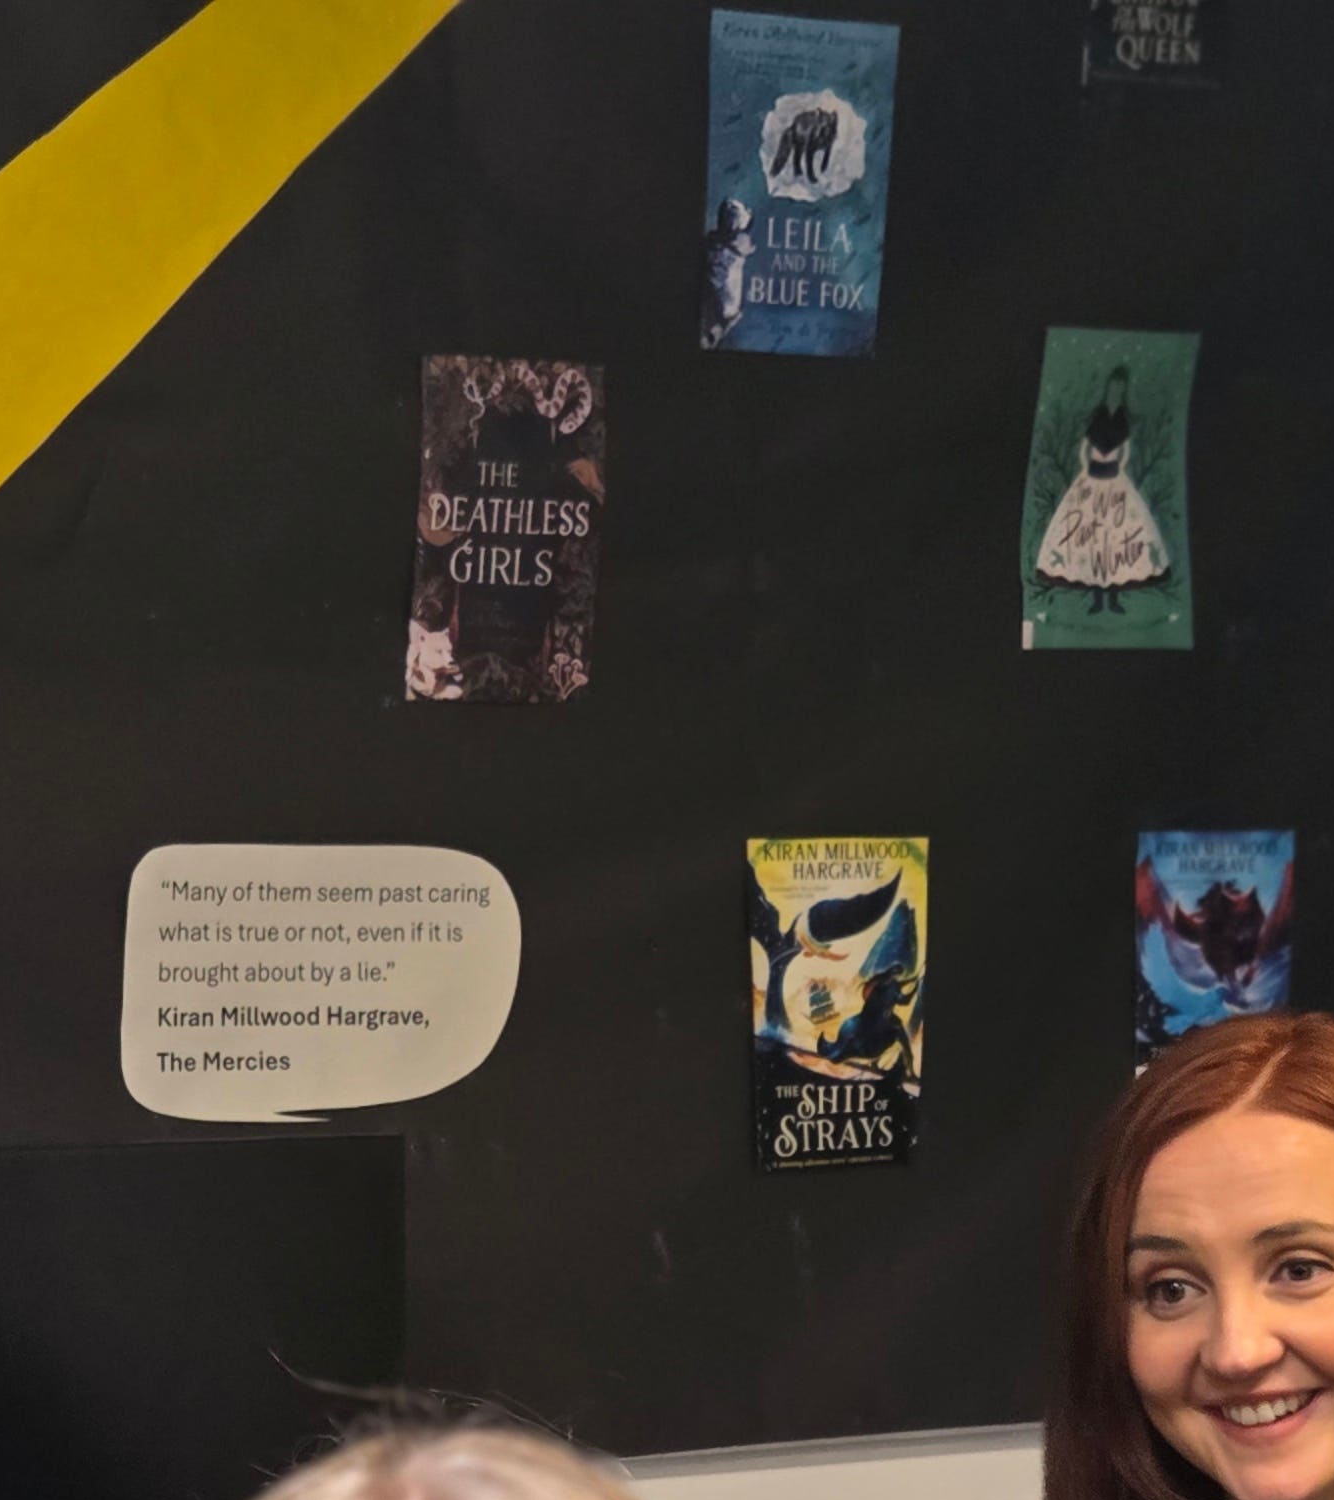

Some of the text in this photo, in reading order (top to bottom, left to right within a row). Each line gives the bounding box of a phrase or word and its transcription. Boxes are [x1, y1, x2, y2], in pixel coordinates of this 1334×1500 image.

[1137, 7, 1195, 36] WOLF
[1116, 34, 1200, 70] QUEEN
[767, 217, 852, 254] LEILA
[772, 254, 840, 275] AND THE
[748, 276, 865, 312] BLUE FOX
[477, 461, 518, 488] THE
[428, 493, 591, 537] DEATHLESS
[449, 540, 553, 587] GIRLS
[763, 842, 910, 861] KIRAN MILLWOOD
[793, 861, 883, 880] HARGRAVE
[161, 880, 491, 908] “Many of them seem past caring
[158, 922, 463, 945] what is true or not, even if it is
[158, 961, 395, 988] brought about by a lie.”
[158, 1006, 429, 1031] Kiran Millwood Hargrave,
[156, 1051, 291, 1072] The Mercies
[775, 1083, 889, 1120] THE SHIP OF
[773, 1114, 895, 1158] STRAYS
